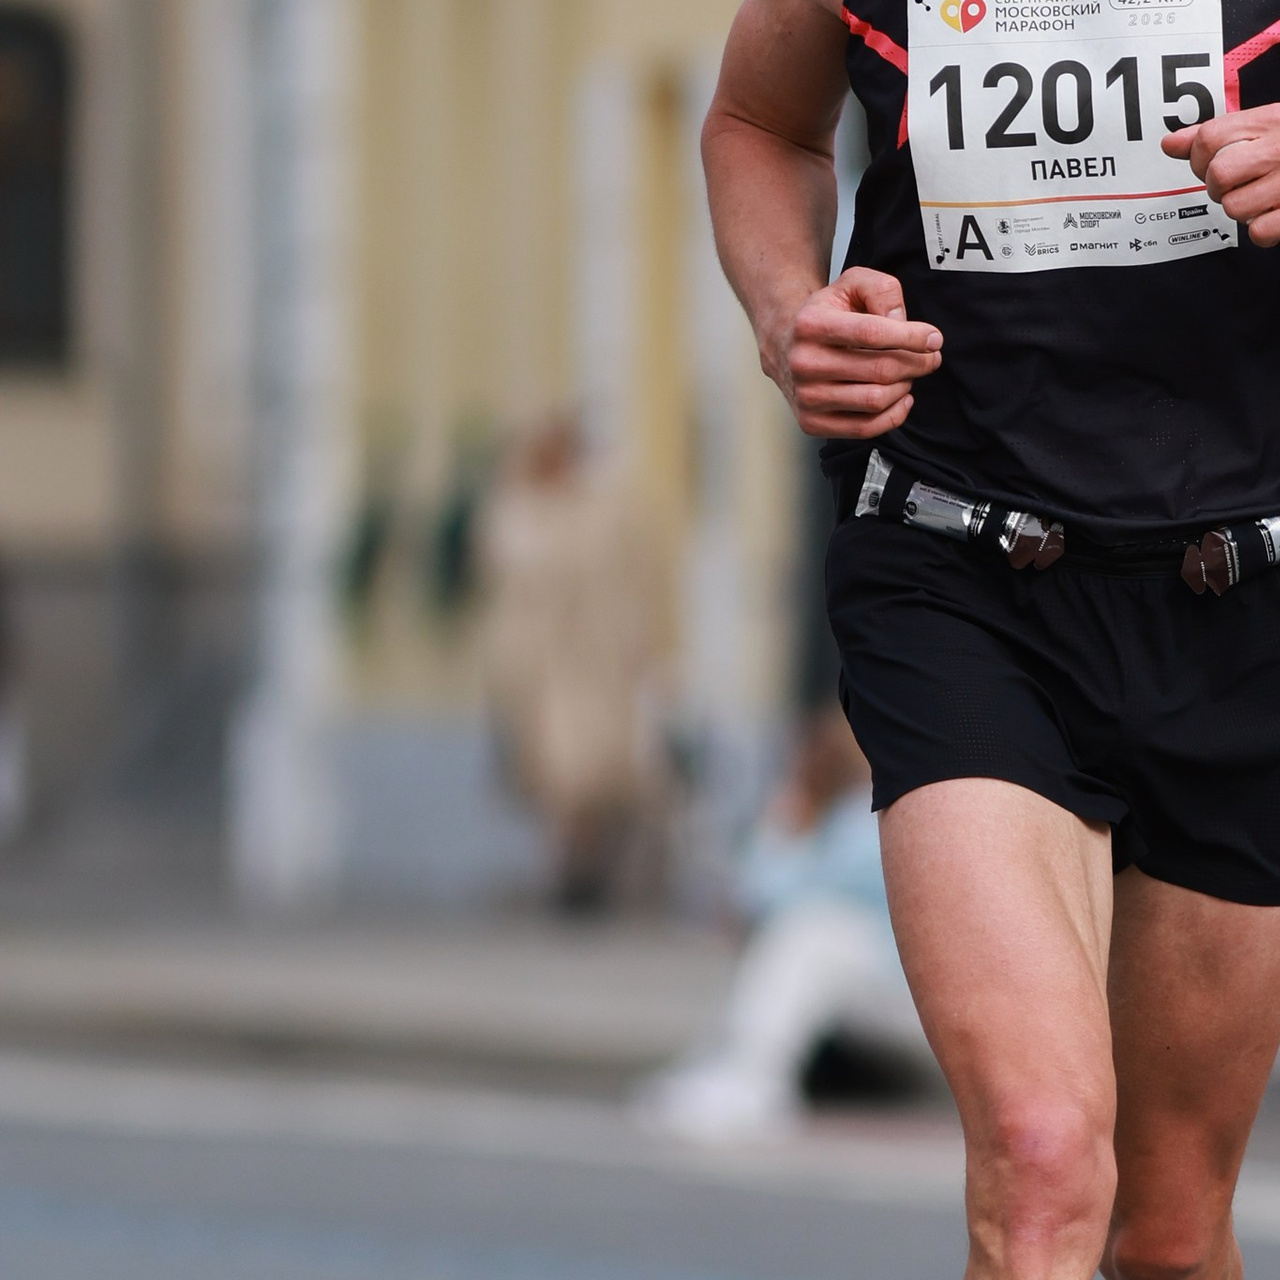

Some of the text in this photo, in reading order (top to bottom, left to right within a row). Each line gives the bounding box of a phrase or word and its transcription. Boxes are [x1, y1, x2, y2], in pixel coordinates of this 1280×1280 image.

[995, 1, 1101, 18] МОСКОВСКИЙ
[1128, 12, 1176, 26] 2026
[995, 19, 1075, 32] МАРАФОН
[929, 53, 1215, 150] 12015
[1031, 157, 1117, 181] ПАВЕЛ
[1079, 209, 1122, 220] МОСКОВСКИЙ
[1149, 211, 1176, 221] СБЕР
[1080, 220, 1101, 229] СПОРТ
[1172, 233, 1201, 243] WINLINE
[1037, 247, 1060, 255] BRICS
